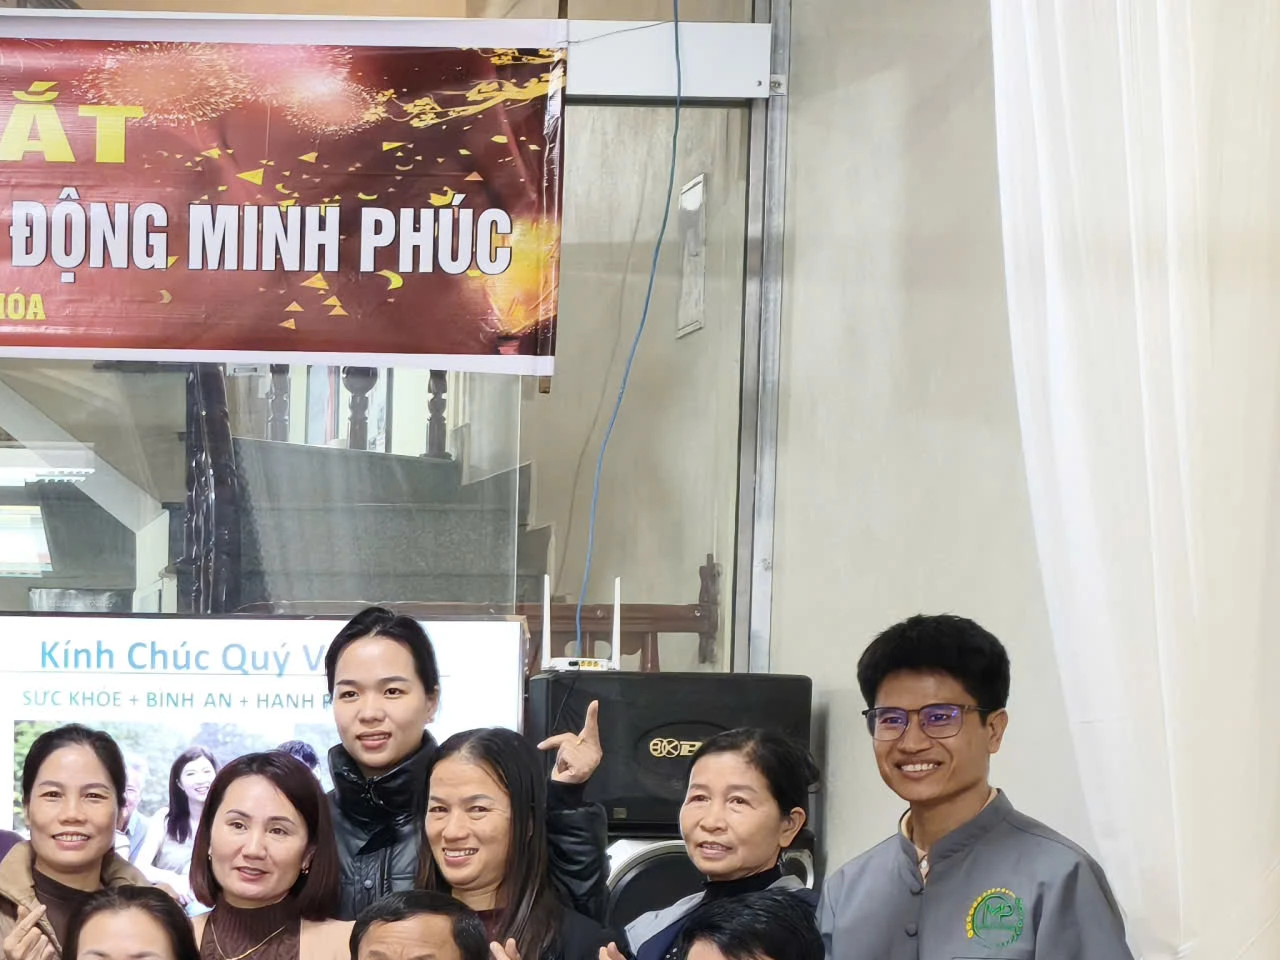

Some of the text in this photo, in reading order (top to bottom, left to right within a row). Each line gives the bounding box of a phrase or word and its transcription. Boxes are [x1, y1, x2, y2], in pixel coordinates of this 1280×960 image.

[10, 186, 170, 284] ĐỘNG
[187, 202, 342, 273] MINH
[359, 192, 515, 276] PHÚC
[40, 640, 115, 671] Kính
[127, 640, 209, 672] Chúc
[221, 642, 291, 678] Quý
[204, 692, 232, 709] AN
